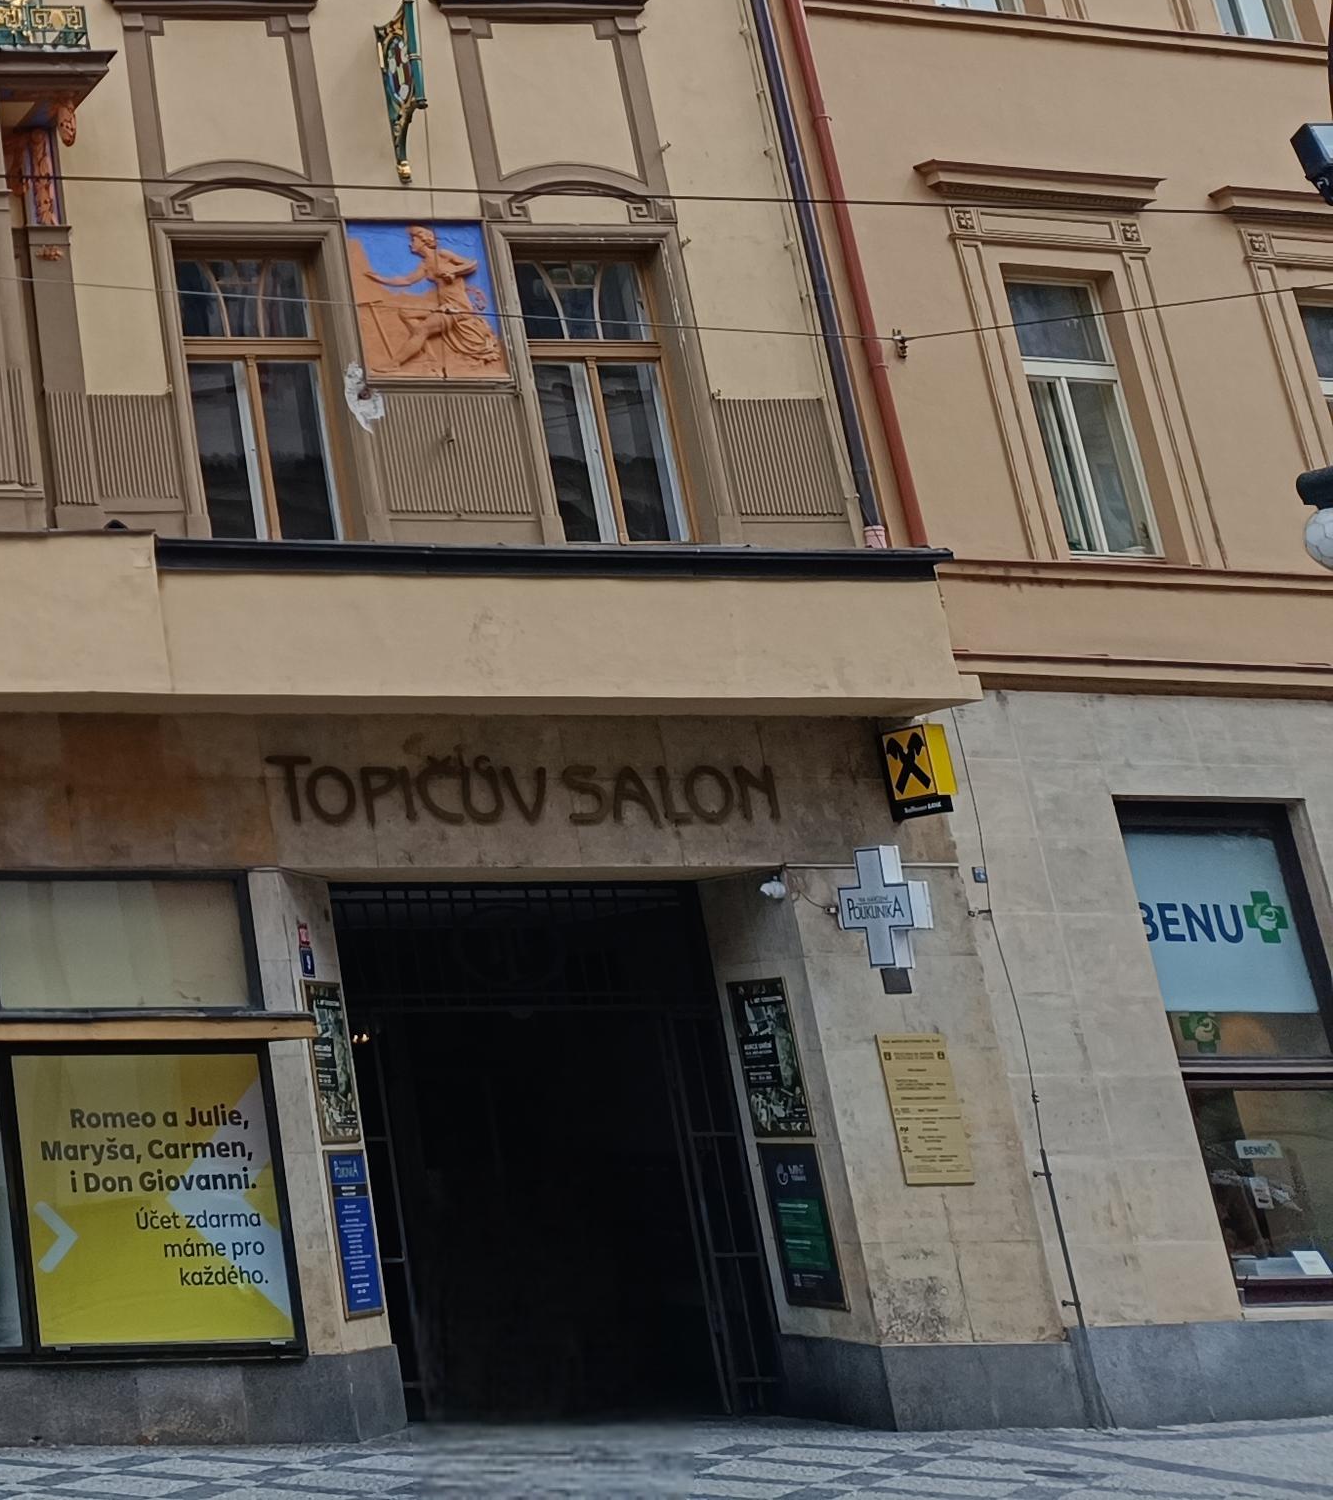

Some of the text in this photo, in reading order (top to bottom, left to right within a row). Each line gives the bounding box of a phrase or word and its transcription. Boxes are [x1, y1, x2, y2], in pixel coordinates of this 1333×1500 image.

[561, 764, 781, 827] SALON
[70, 1104, 249, 1130] Romeo a Julie,
[41, 1138, 253, 1166] Maryša, Carmen,
[70, 1167, 257, 1193] i Don Giovanni.
[136, 1207, 261, 1230] Účet zdarma
[163, 1240, 265, 1260] máme pro
[179, 1266, 269, 1286] každého.
